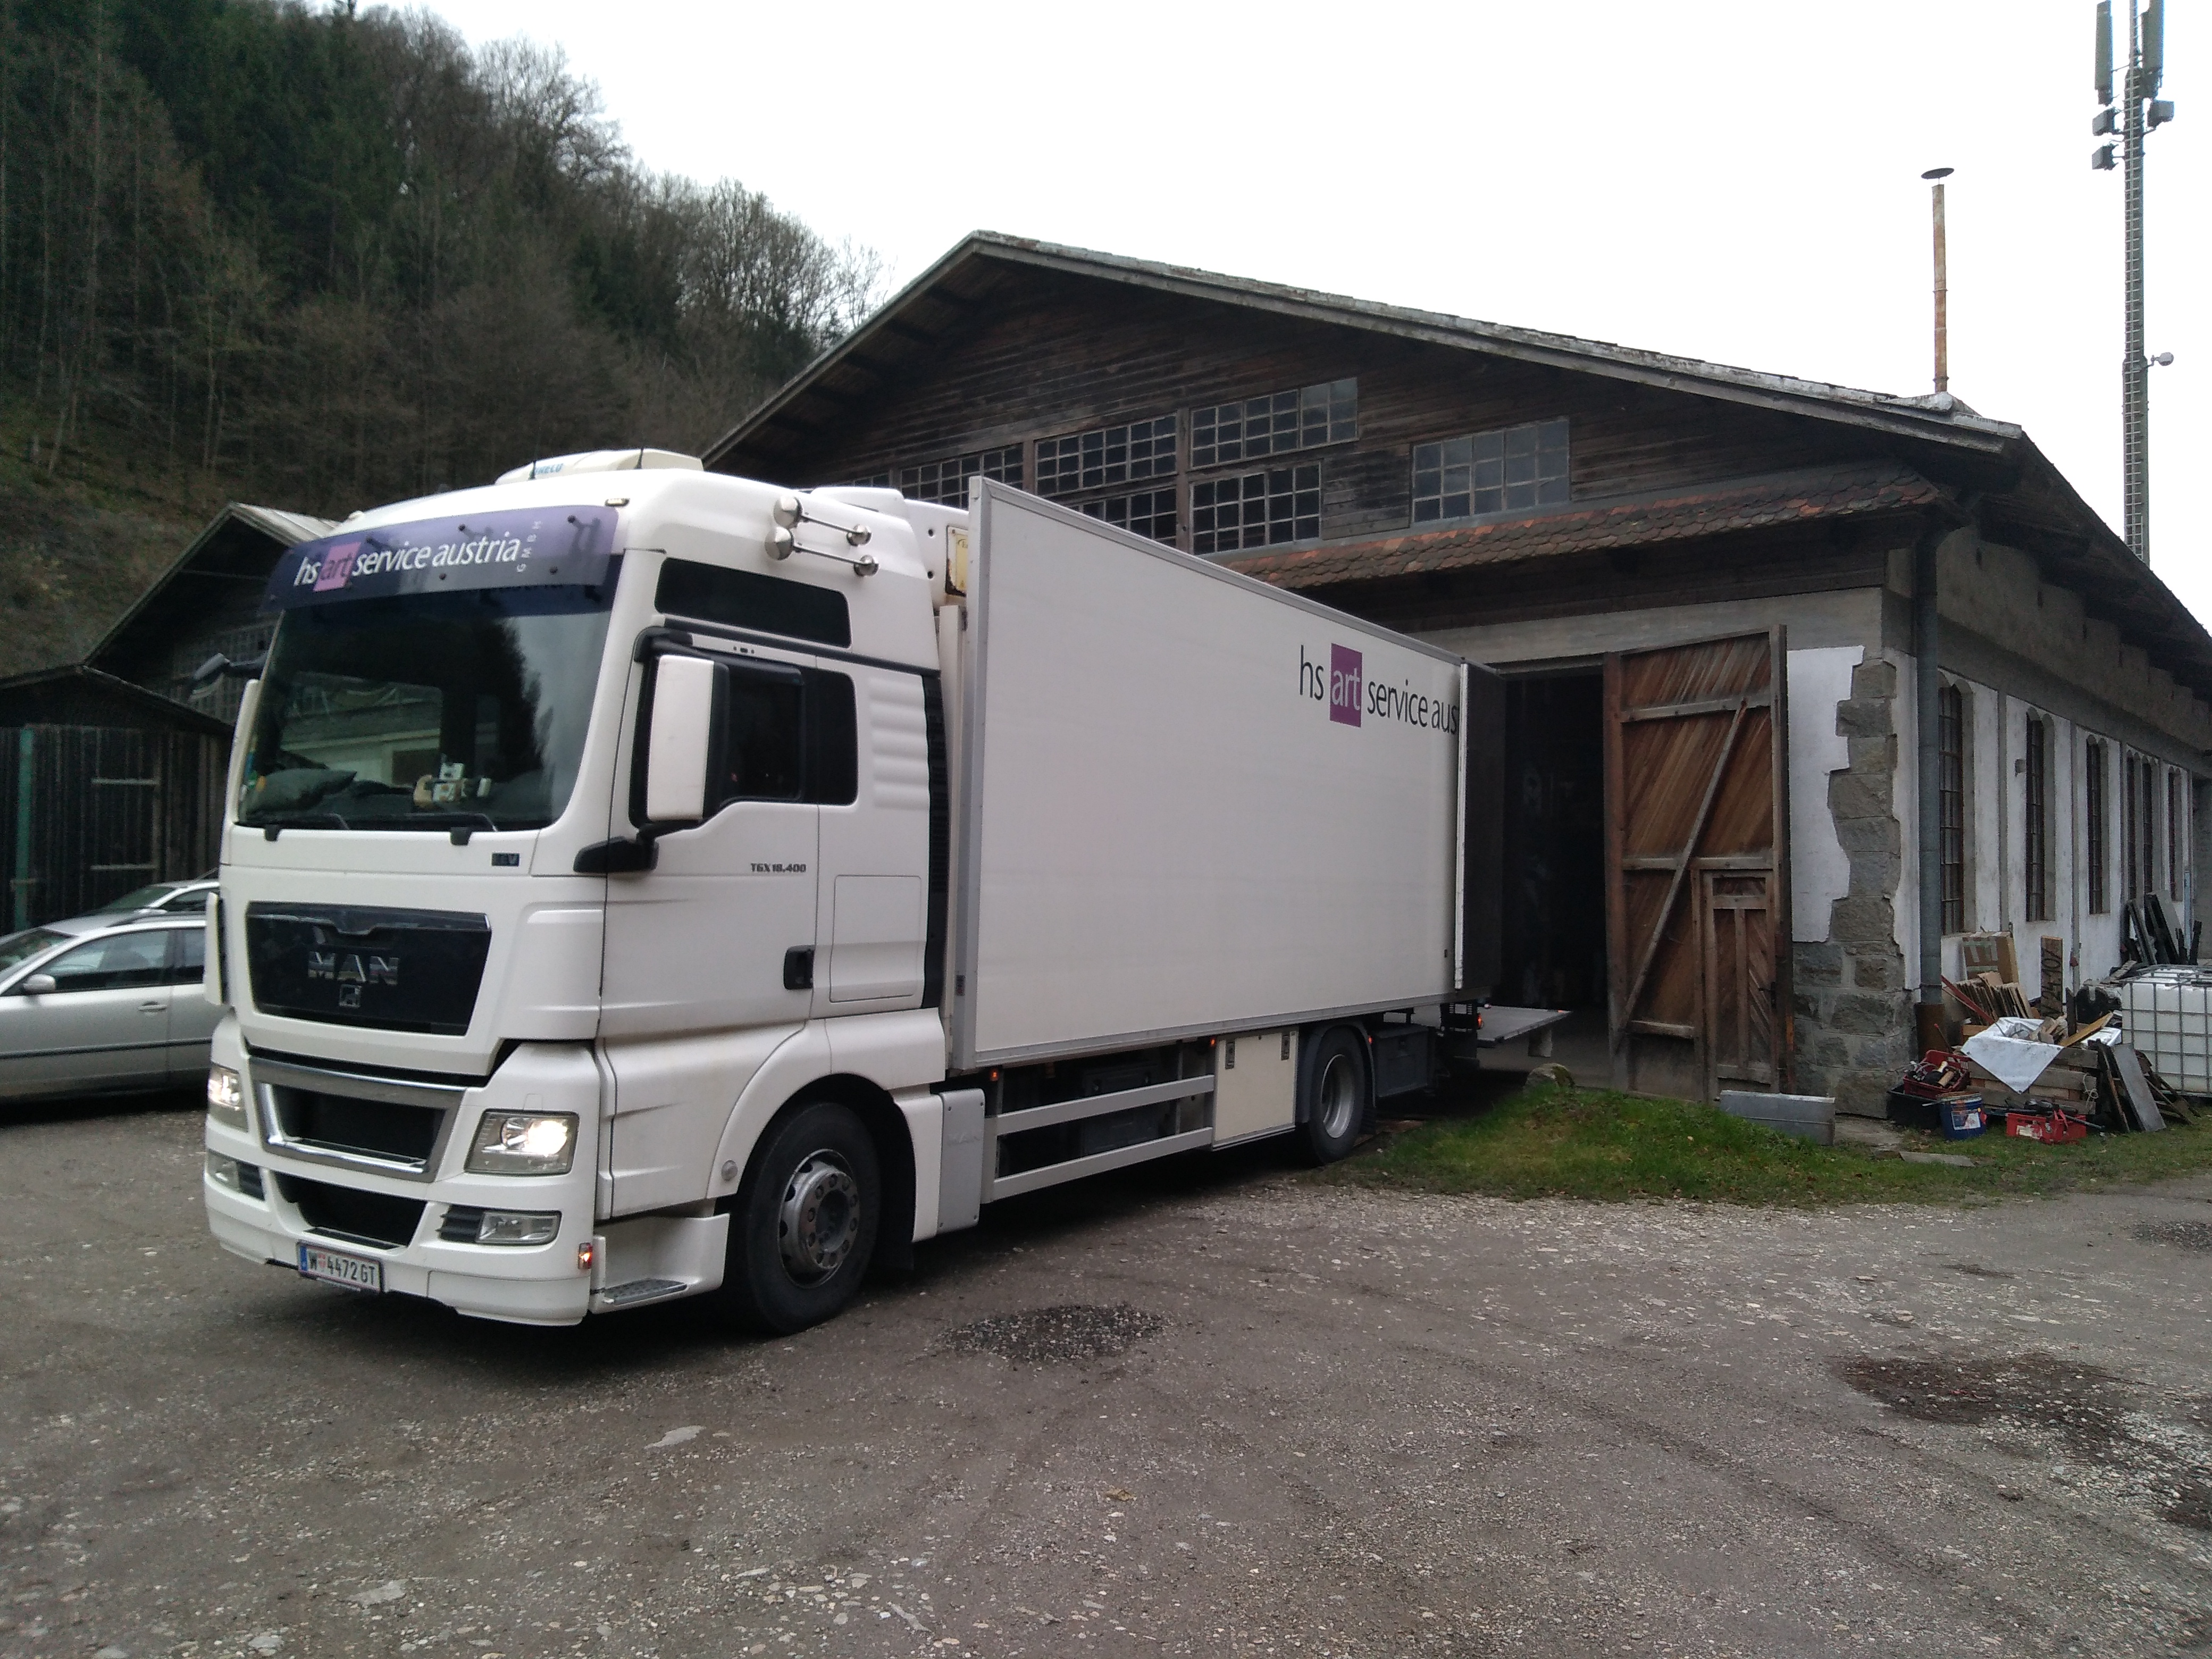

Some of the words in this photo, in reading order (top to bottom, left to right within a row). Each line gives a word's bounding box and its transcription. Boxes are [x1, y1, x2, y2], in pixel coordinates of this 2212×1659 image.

[294, 556, 321, 586] hs
[320, 554, 353, 580] art
[351, 541, 432, 577] service
[432, 531, 521, 567] austria
[1299, 644, 1325, 701] hs
[1331, 668, 1361, 710] art
[1367, 679, 1428, 728] service
[308, 951, 399, 985] MAN
[308, 1252, 317, 1270] W
